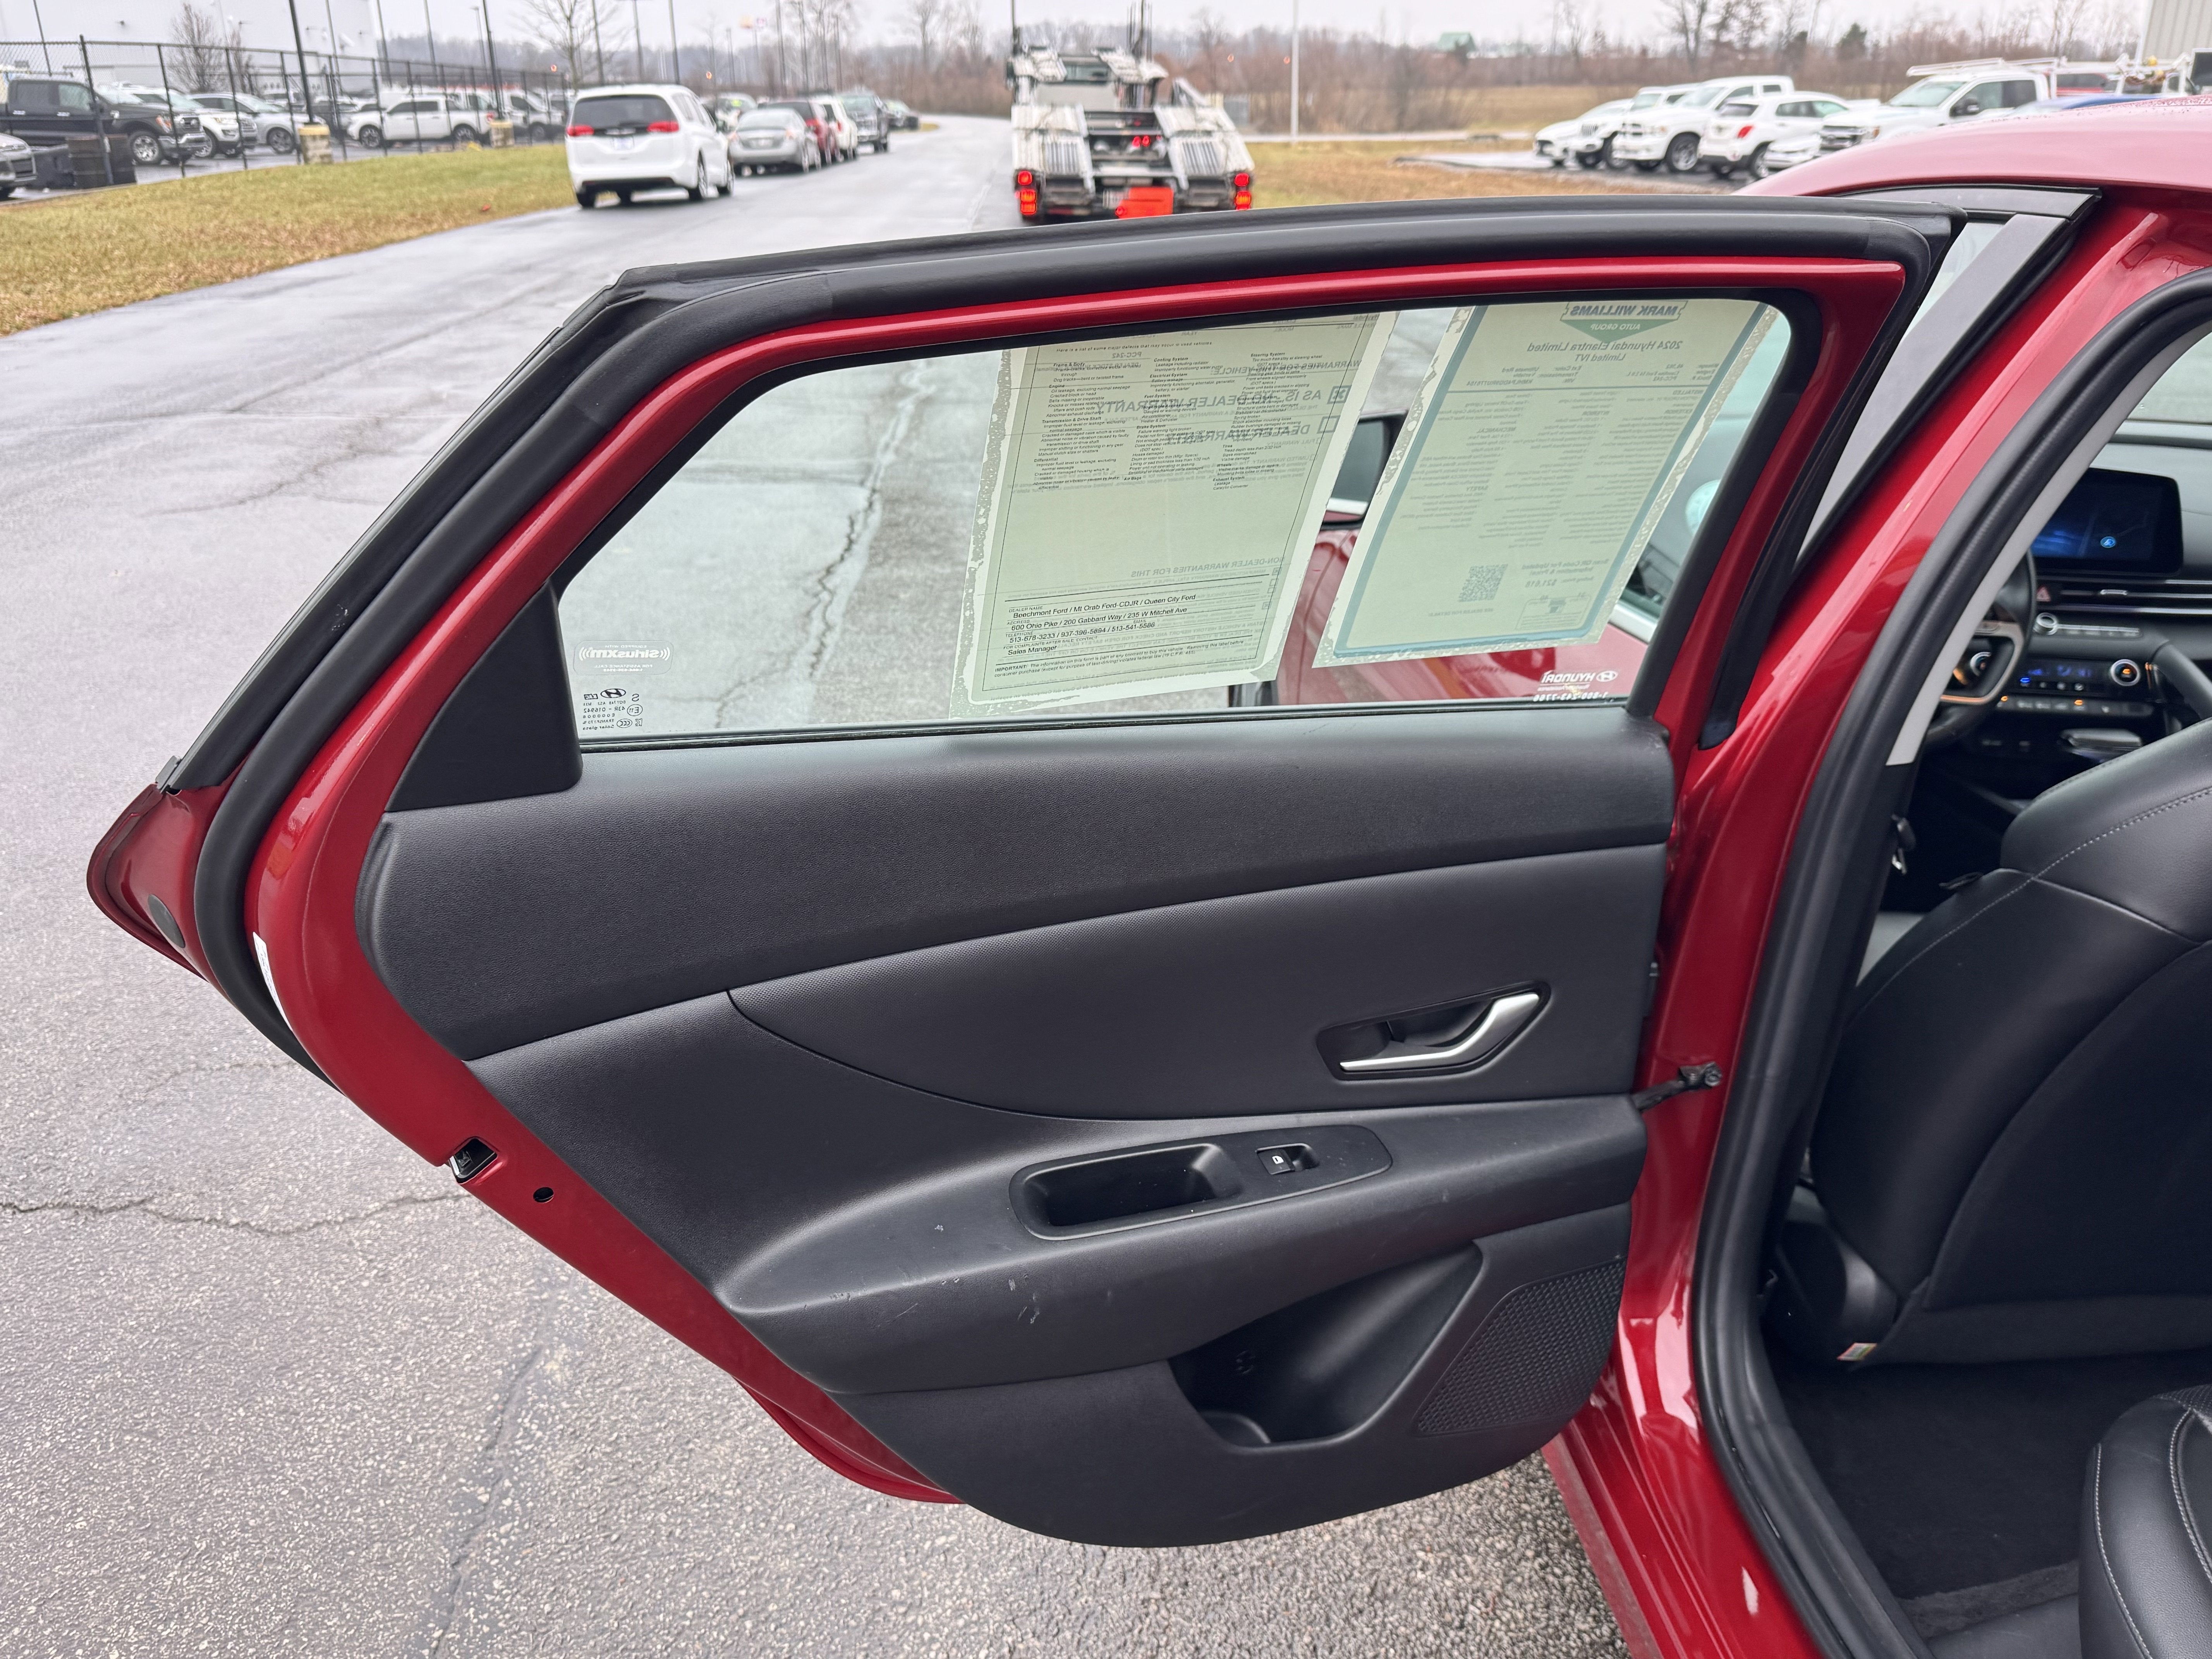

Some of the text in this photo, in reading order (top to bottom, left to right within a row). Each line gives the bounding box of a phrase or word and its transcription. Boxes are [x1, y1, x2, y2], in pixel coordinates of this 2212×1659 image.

[1013, 610, 1051, 618] Beechmont
[1102, 600, 1139, 609] Ford-CDJR
[1078, 615, 1106, 624] Gabbard
